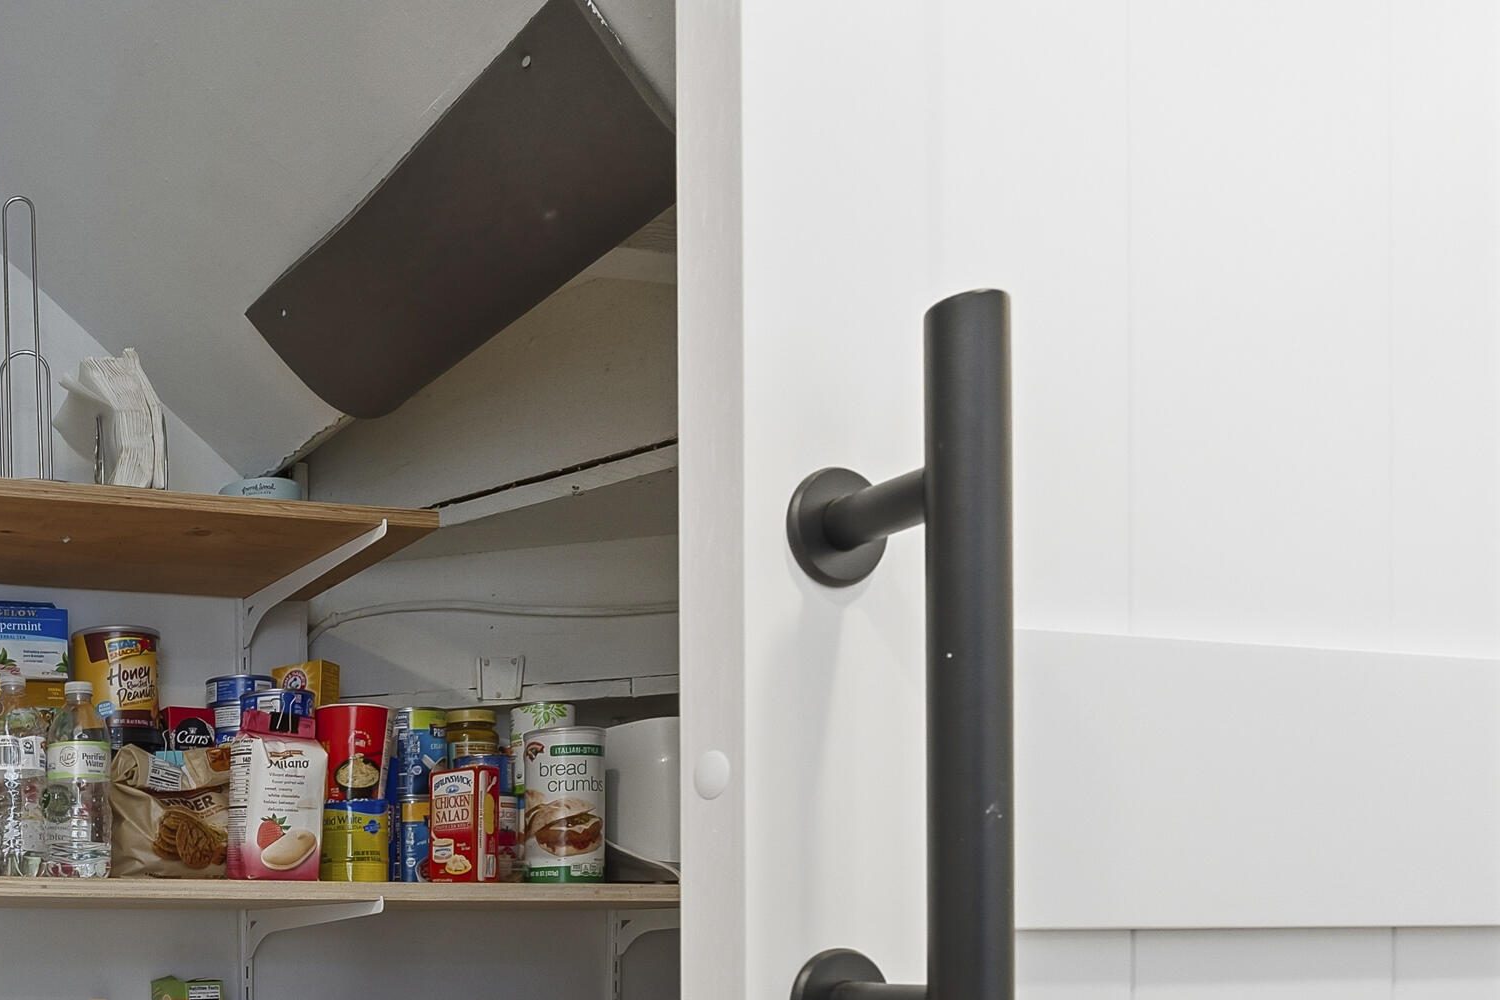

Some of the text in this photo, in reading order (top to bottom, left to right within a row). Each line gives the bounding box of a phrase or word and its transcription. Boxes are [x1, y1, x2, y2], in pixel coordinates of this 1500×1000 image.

[107, 639, 138, 652] STAR
[107, 664, 152, 688] Honey
[267, 759, 309, 770] Milano
[539, 760, 588, 778] bread
[434, 774, 473, 791] BRUNSWICK
[547, 779, 604, 793] crumbs
[435, 795, 470, 810] CHICKEN
[324, 815, 362, 826] olid White
[435, 808, 470, 824] SALAD
